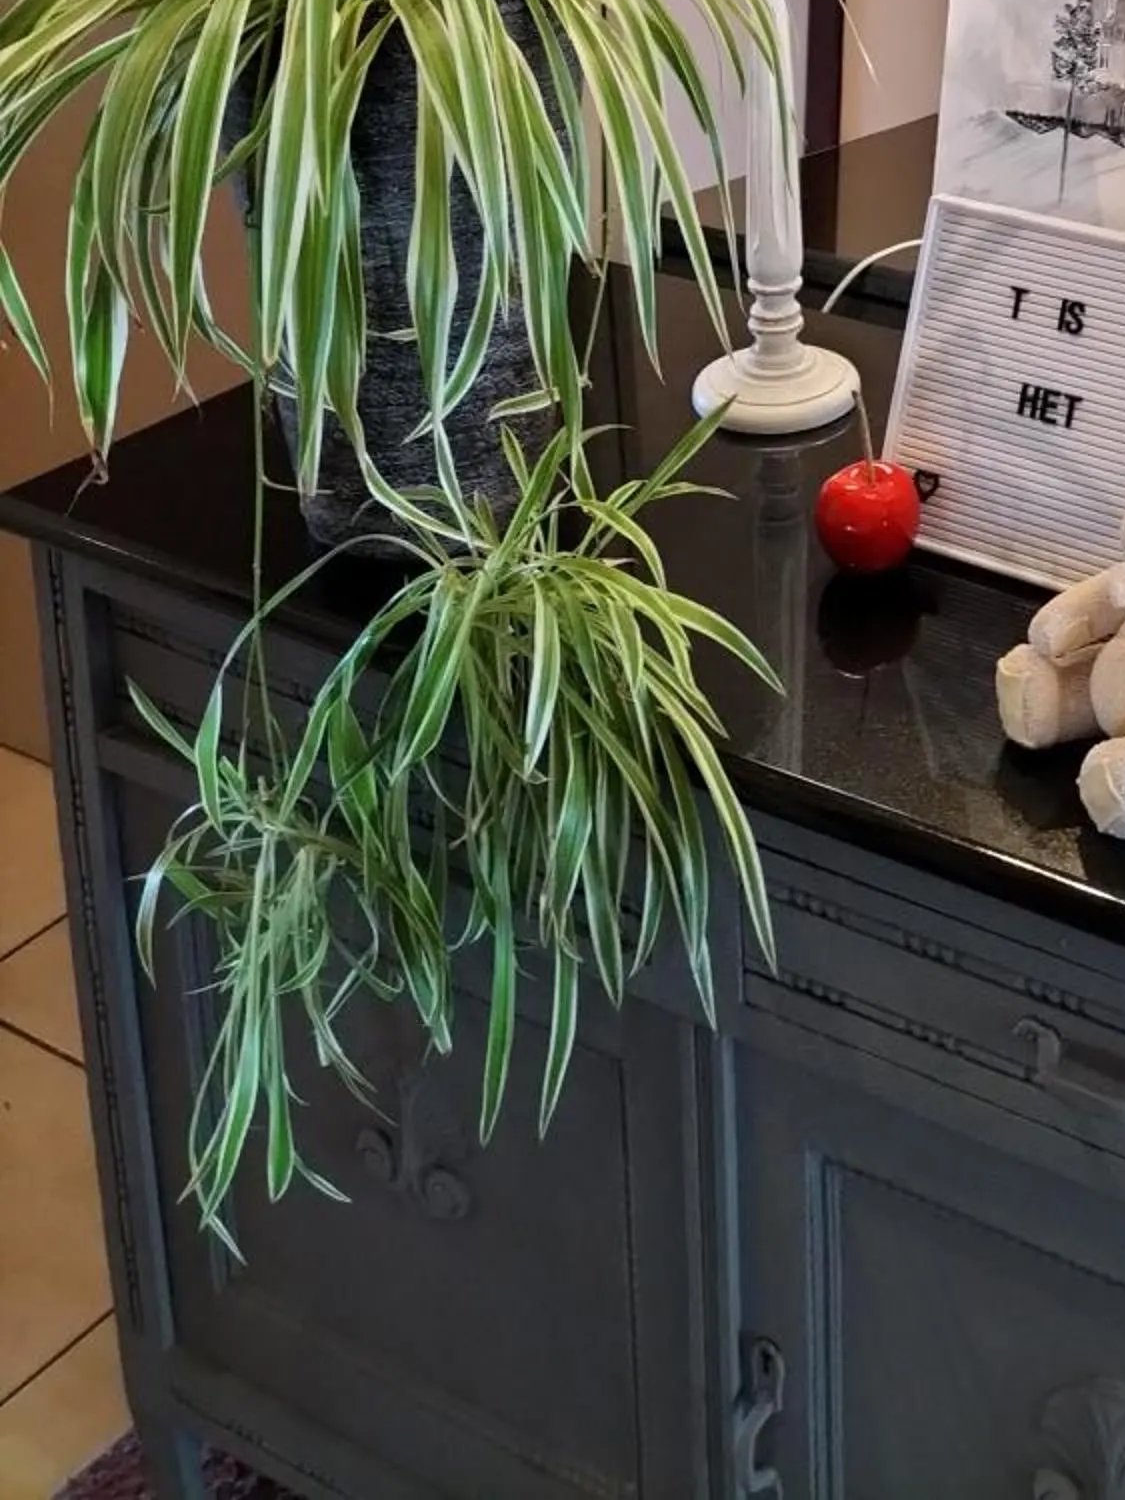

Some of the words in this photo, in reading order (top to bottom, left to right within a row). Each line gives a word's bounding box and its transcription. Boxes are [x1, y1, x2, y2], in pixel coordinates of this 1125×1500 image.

[1010, 286, 1030, 320] T
[1057, 298, 1086, 336] IS
[1017, 382, 1083, 429] HET
